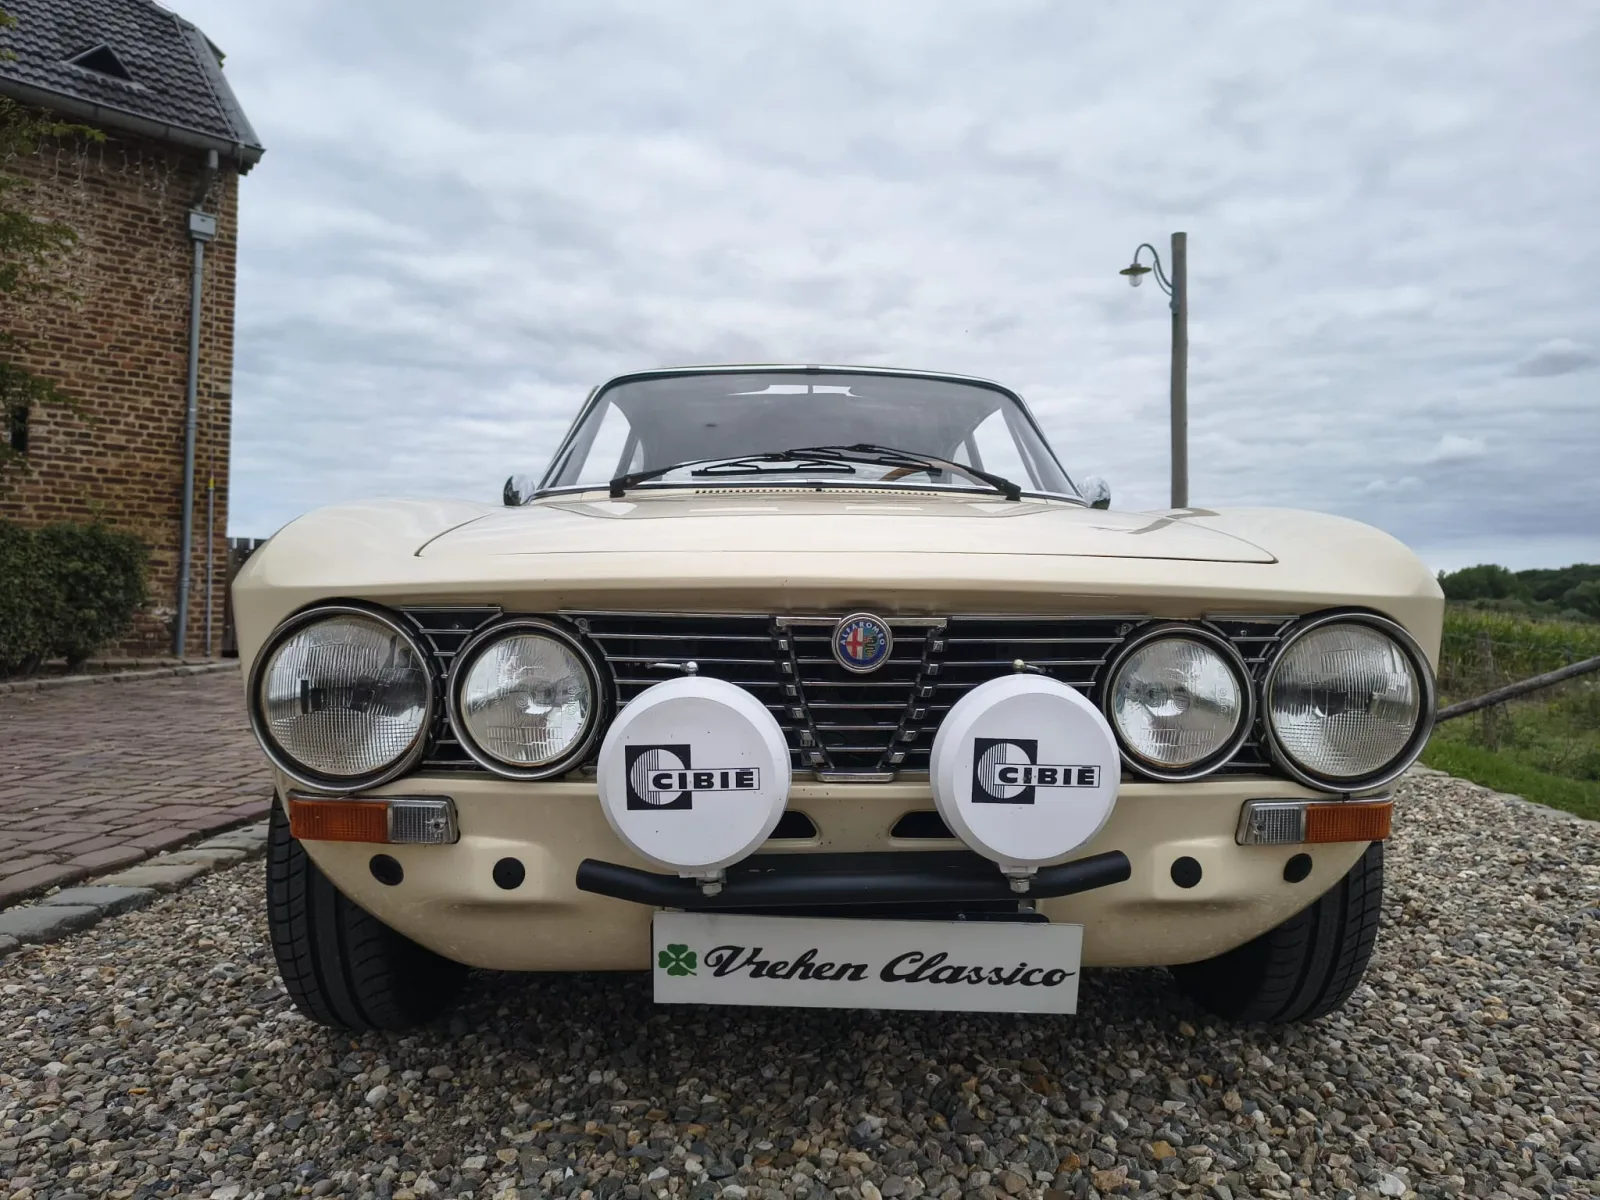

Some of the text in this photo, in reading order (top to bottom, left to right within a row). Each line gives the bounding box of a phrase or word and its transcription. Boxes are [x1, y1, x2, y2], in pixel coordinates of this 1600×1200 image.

[840, 621, 885, 645] ALFA ROMEO
[704, 945, 1076, 987] Vrehen Classico
